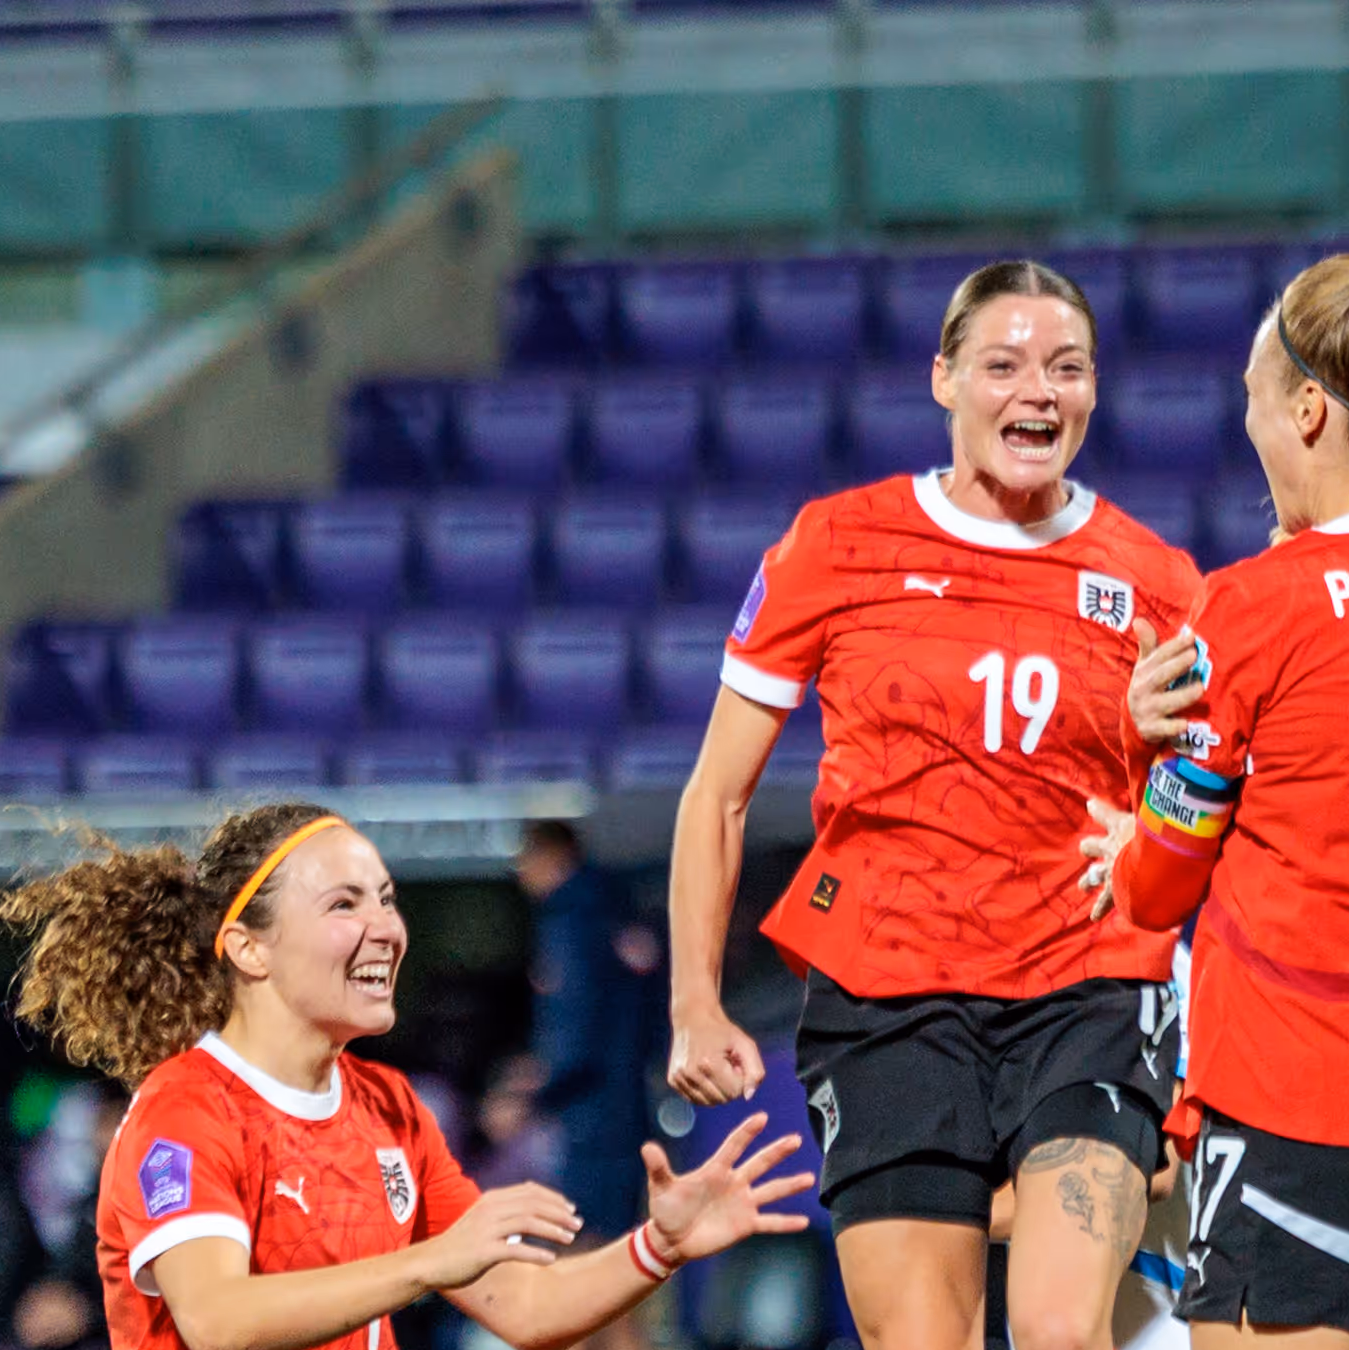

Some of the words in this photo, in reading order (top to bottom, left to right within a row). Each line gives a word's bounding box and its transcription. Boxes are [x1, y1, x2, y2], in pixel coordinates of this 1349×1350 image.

[968, 651, 1059, 755] 19
[1163, 774, 1182, 801] THE
[1152, 788, 1195, 827] CHANGE
